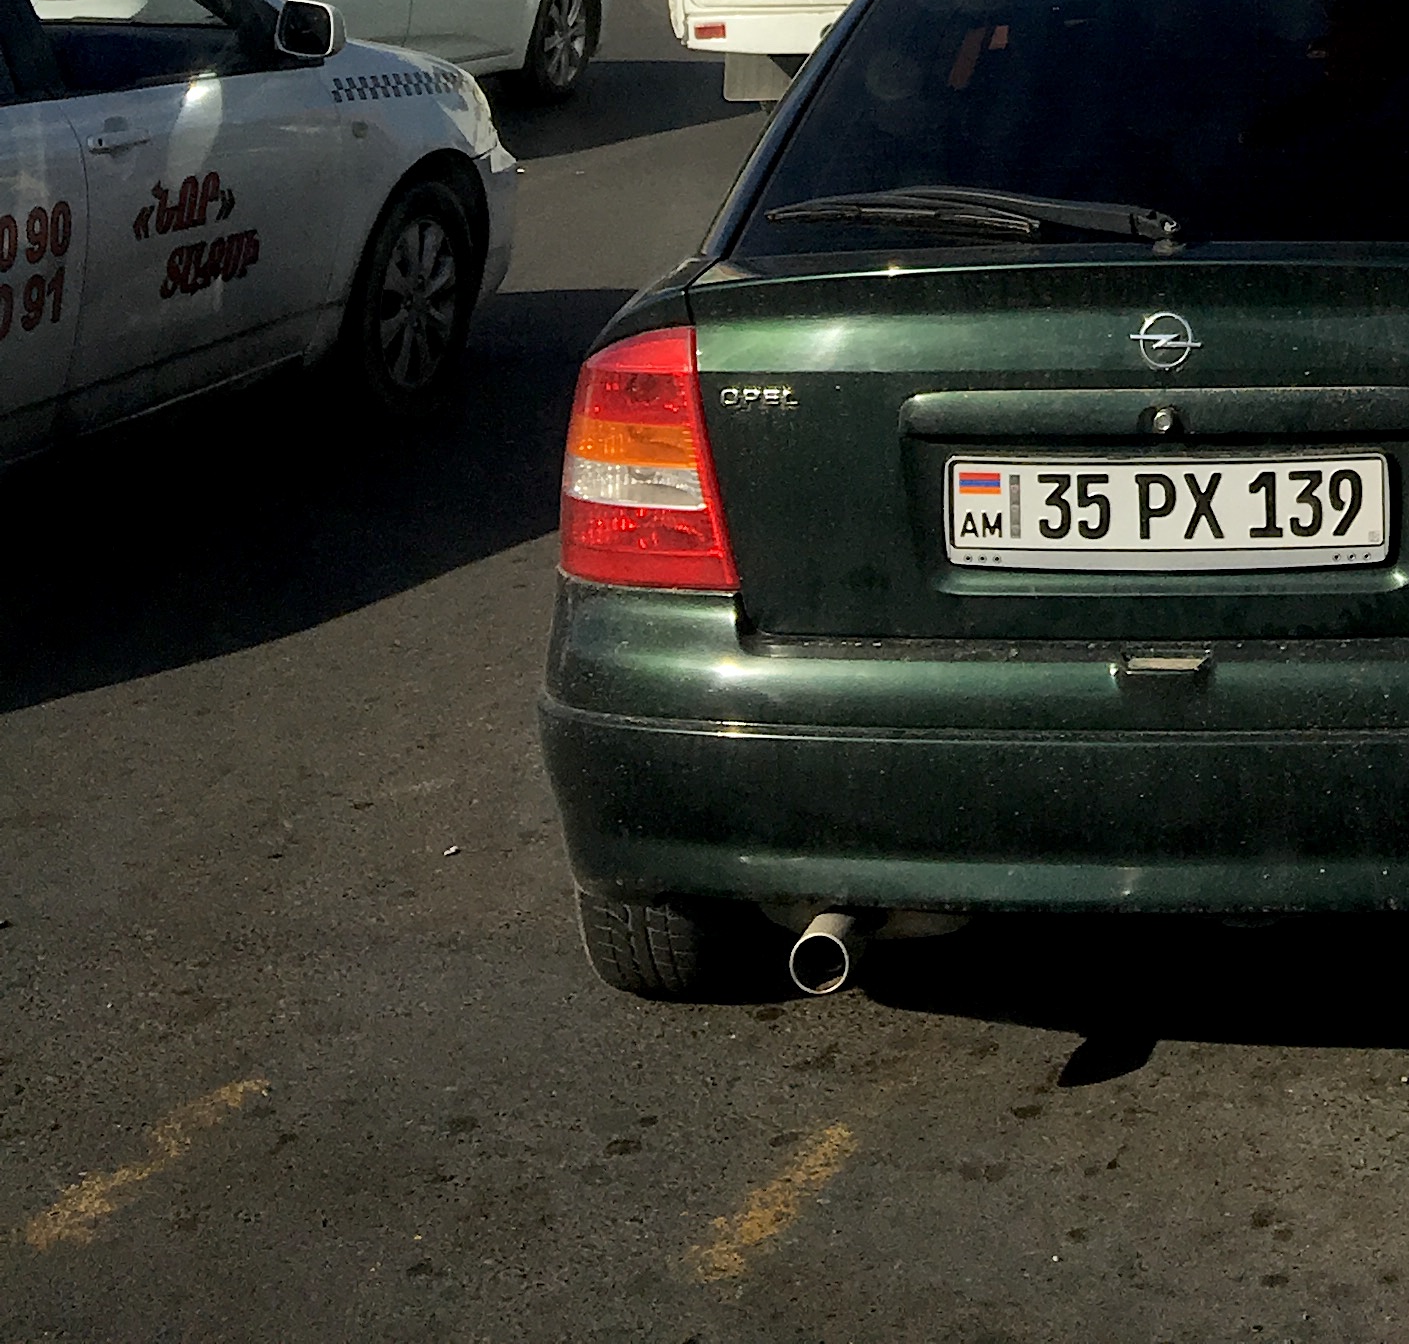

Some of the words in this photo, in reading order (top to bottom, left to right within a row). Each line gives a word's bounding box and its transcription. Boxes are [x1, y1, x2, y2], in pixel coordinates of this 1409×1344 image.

[25, 200, 72, 265] 90
[20, 266, 66, 332] 91
[720, 385, 800, 409] OPEL
[960, 511, 1002, 539] AM
[1037, 473, 1111, 540] 35
[1134, 472, 1225, 540] PX
[1248, 469, 1364, 538] 139
